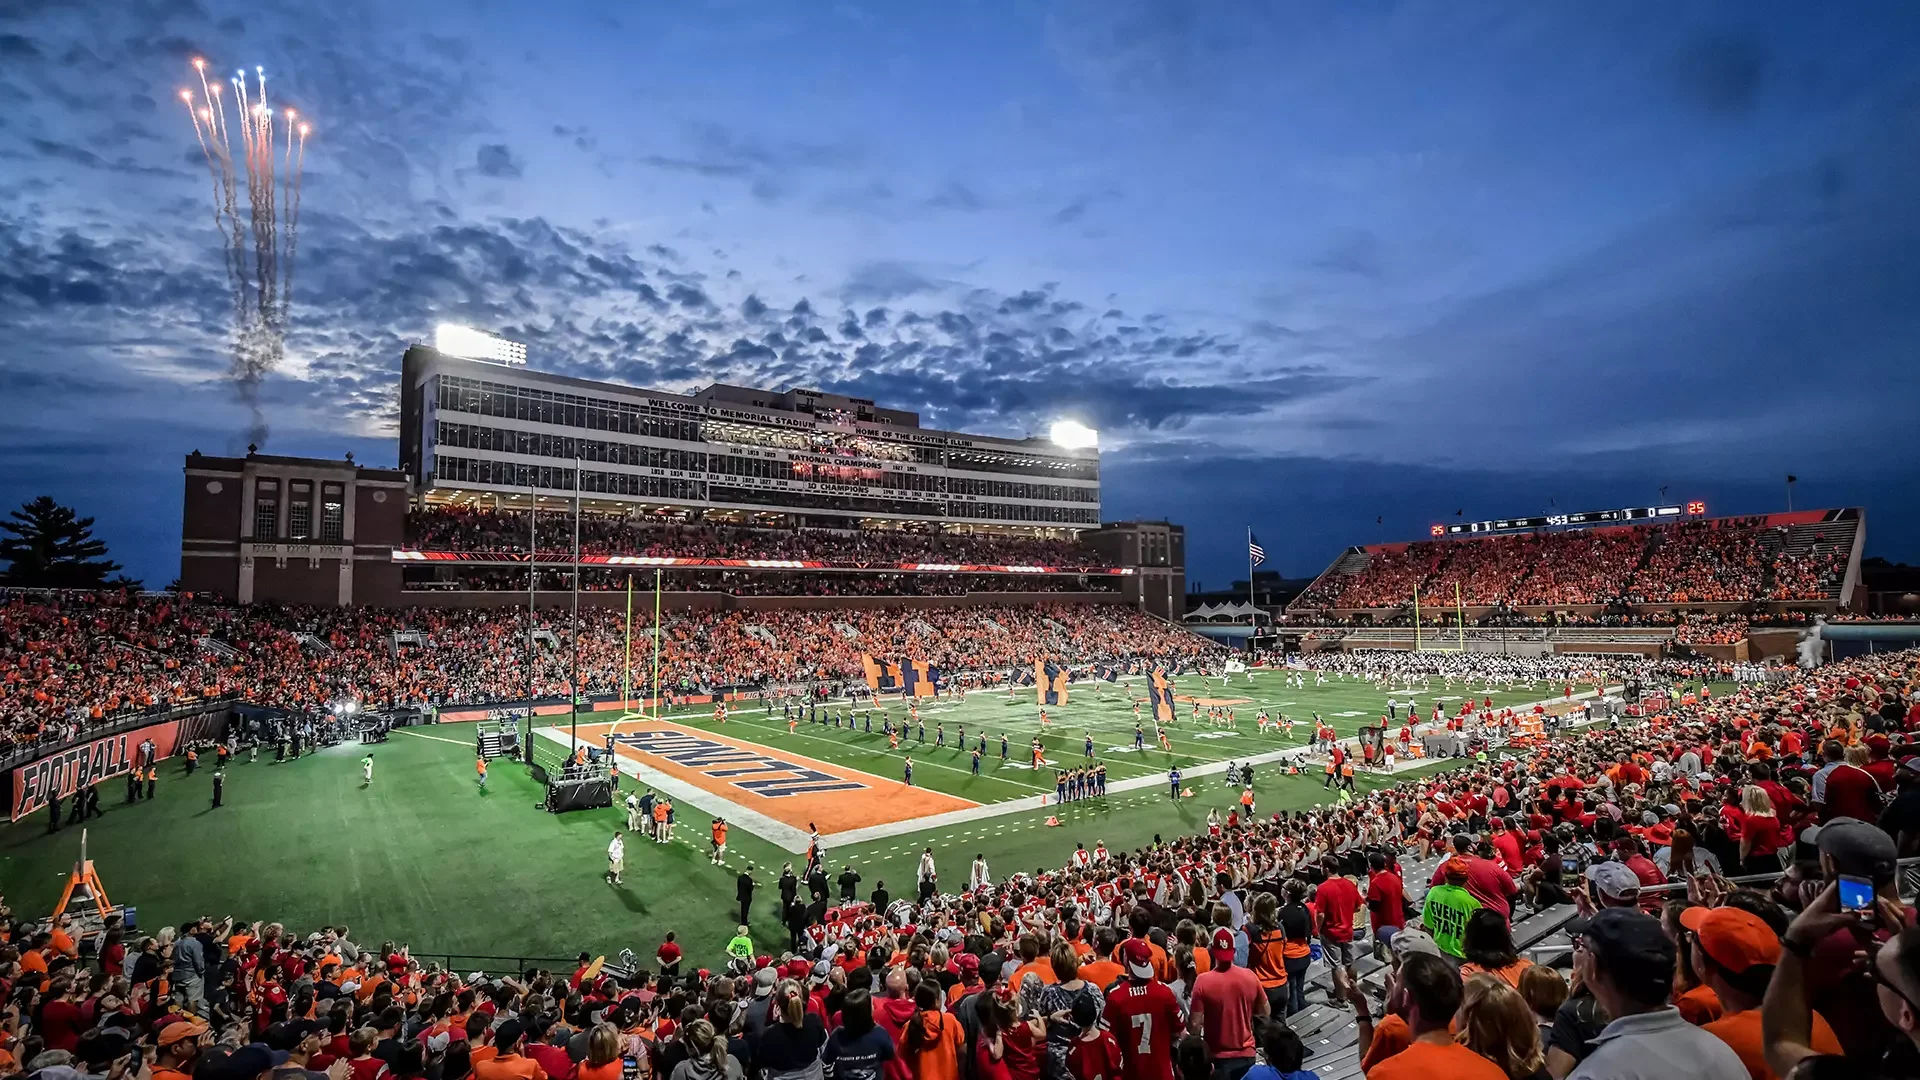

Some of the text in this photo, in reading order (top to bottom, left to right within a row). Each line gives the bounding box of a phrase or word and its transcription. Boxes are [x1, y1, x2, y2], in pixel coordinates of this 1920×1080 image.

[648, 399, 817, 429] WELCOME TO MEMORIAL STADIUM
[855, 427, 973, 447] HOME OF THE FIGHTING ILLINI
[788, 454, 832, 464] NATIONAL
[834, 459, 882, 470] CHAMPIONS
[820, 483, 869, 494] CHAMPIONS
[1648, 507, 1656, 518] 0
[1689, 503, 1704, 514] 25
[1546, 515, 1568, 525] 4:53
[1432, 526, 1444, 535] 25
[1471, 523, 1478, 532] 0
[600, 730, 873, 798] ILLINOIS
[18, 735, 130, 816] FOOTBALL
[1147, 879, 1156, 889] N
[1430, 901, 1464, 925] EVENT
[812, 927, 820, 936] N
[831, 926, 839, 935] N
[1433, 916, 1463, 939] STAFF
[865, 935, 874, 945] N
[1128, 985, 1148, 997] FROST
[1131, 1013, 1152, 1054] 7
